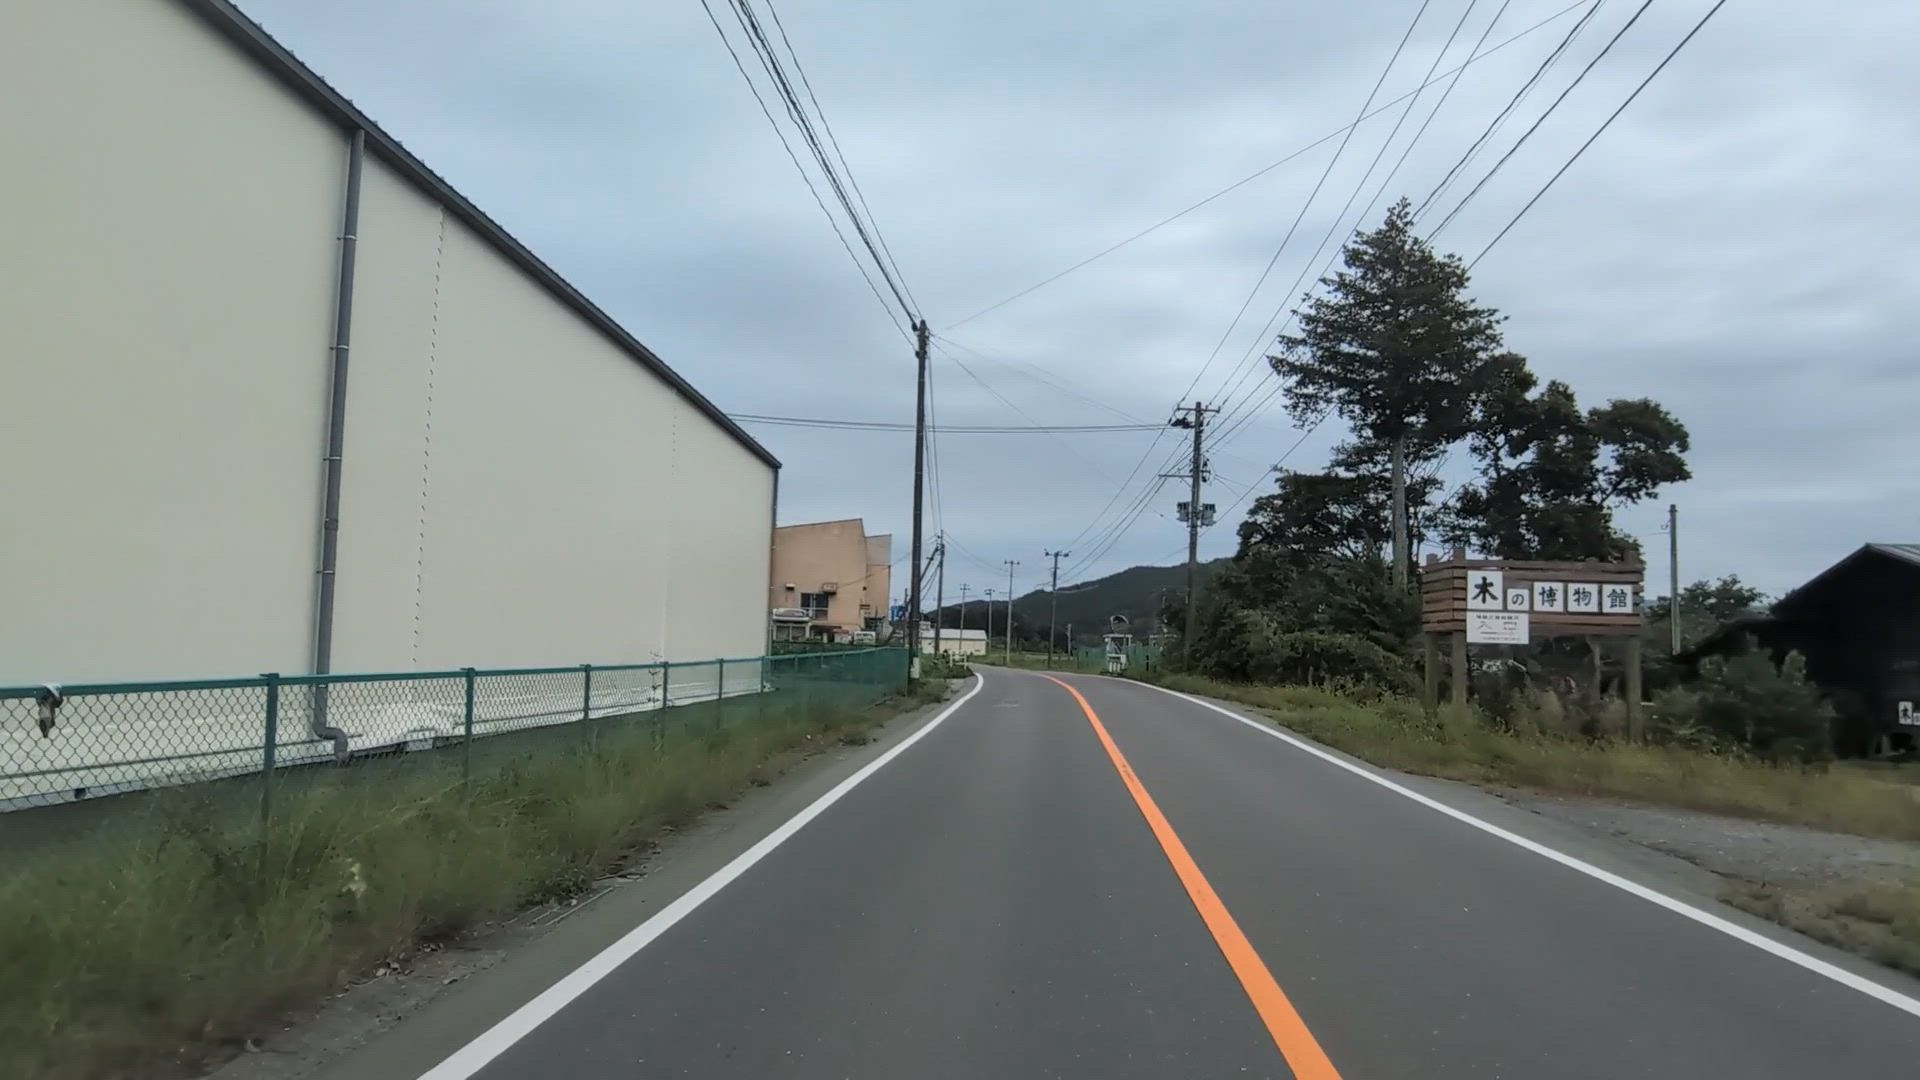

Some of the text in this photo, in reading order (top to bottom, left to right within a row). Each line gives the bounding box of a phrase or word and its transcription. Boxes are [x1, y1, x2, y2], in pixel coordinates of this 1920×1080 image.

[1471, 575, 1628, 609] 木の博物館
